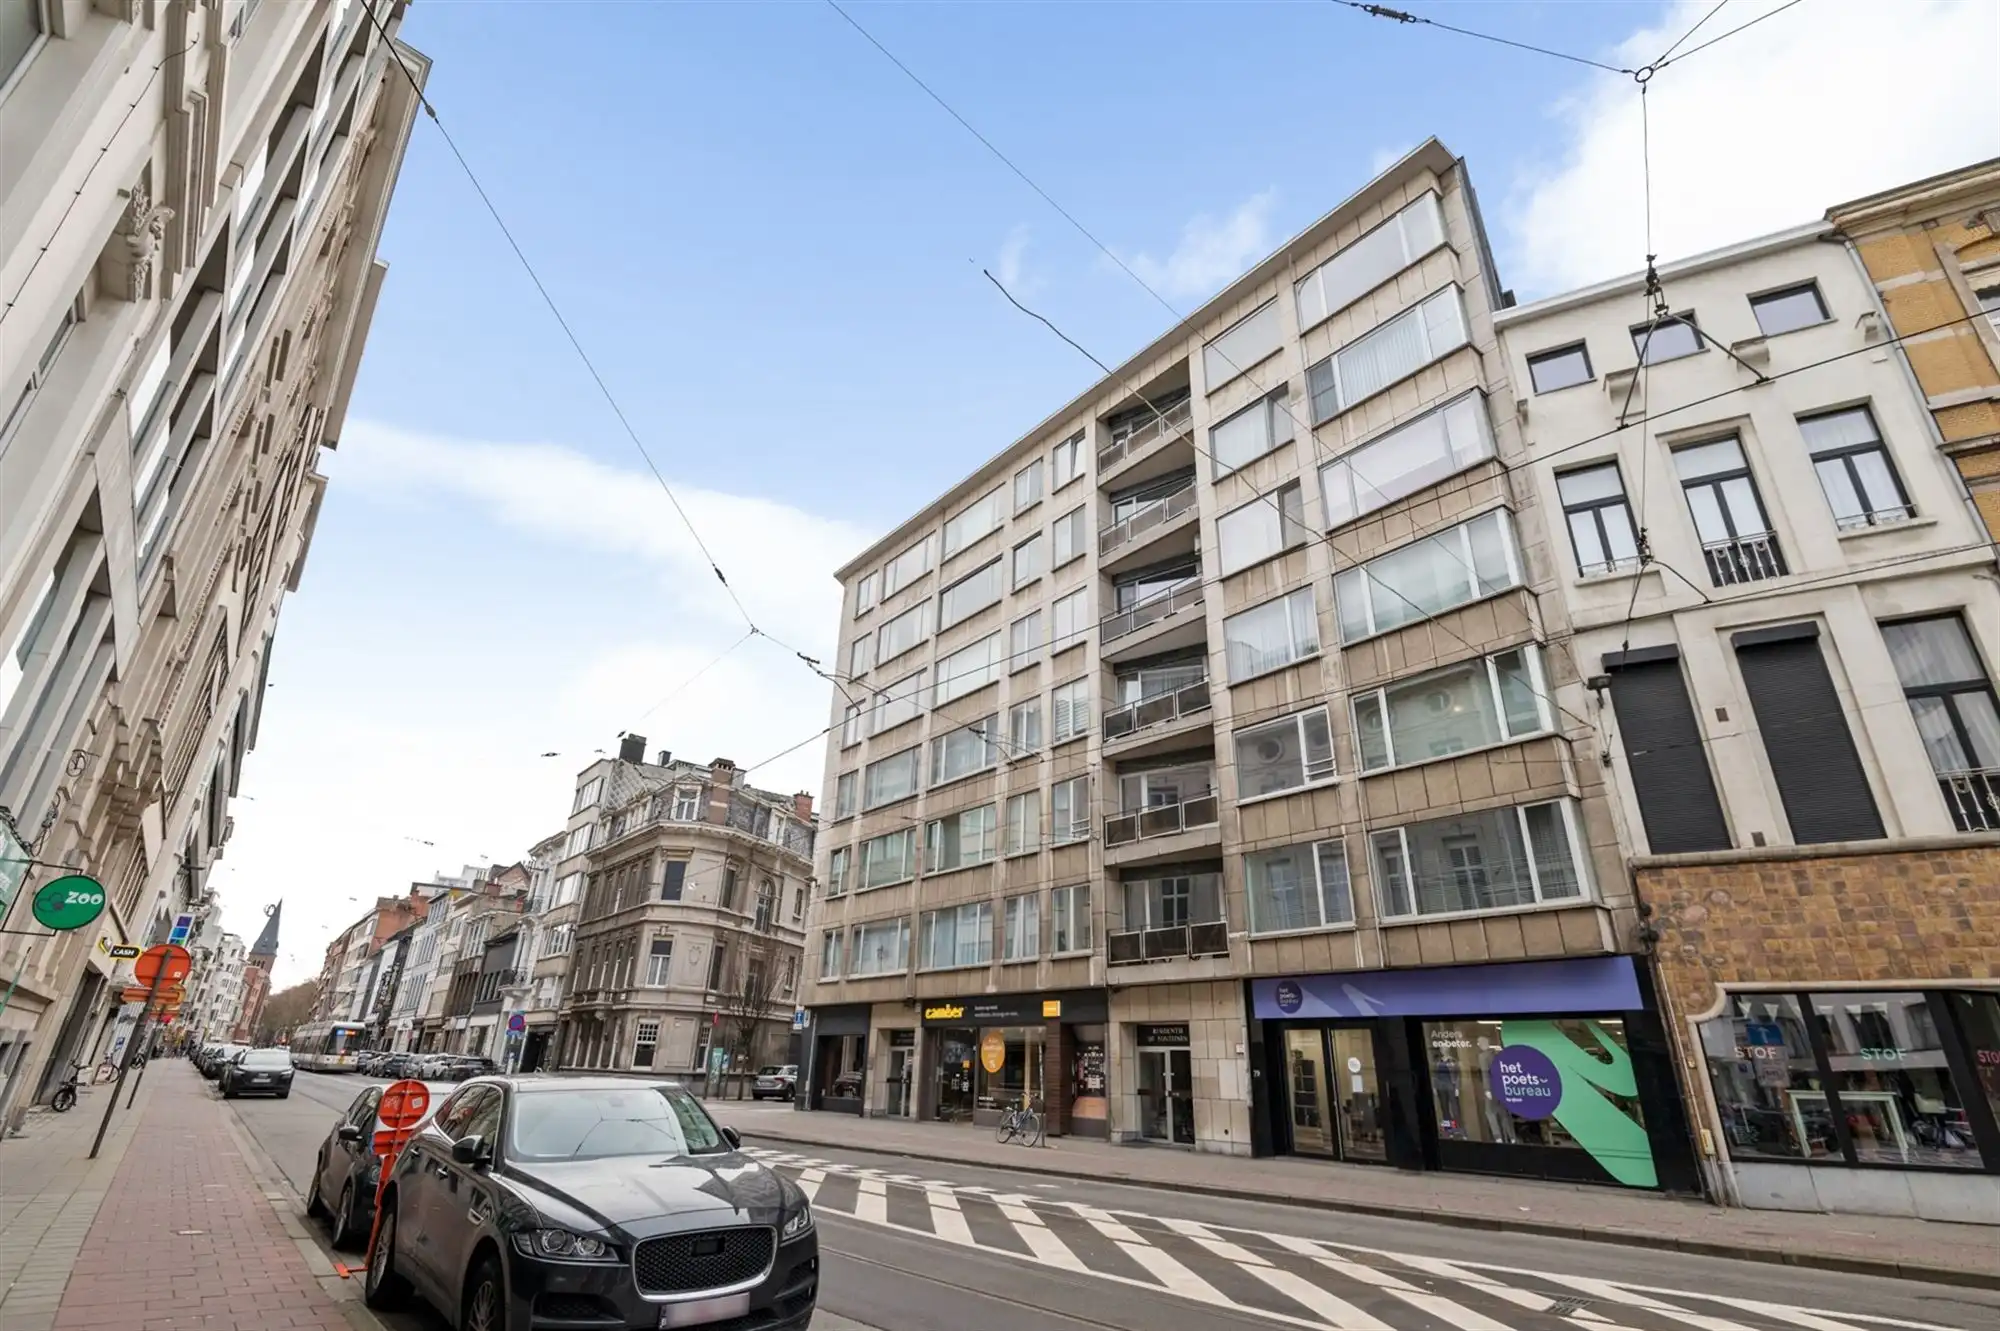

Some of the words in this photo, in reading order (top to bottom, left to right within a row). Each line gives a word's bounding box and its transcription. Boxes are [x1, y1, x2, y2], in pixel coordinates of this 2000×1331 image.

[113, 948, 135, 956] CASH
[1431, 1030, 1463, 1039] Anders
[1734, 1046, 1777, 1059] STOF
[1860, 1048, 1908, 1061] STOF
[1977, 1050, 2000, 1064] STO
[1499, 1061, 1523, 1074] het
[1502, 1074, 1540, 1086] poets
[1504, 1085, 1551, 1097] bureau
